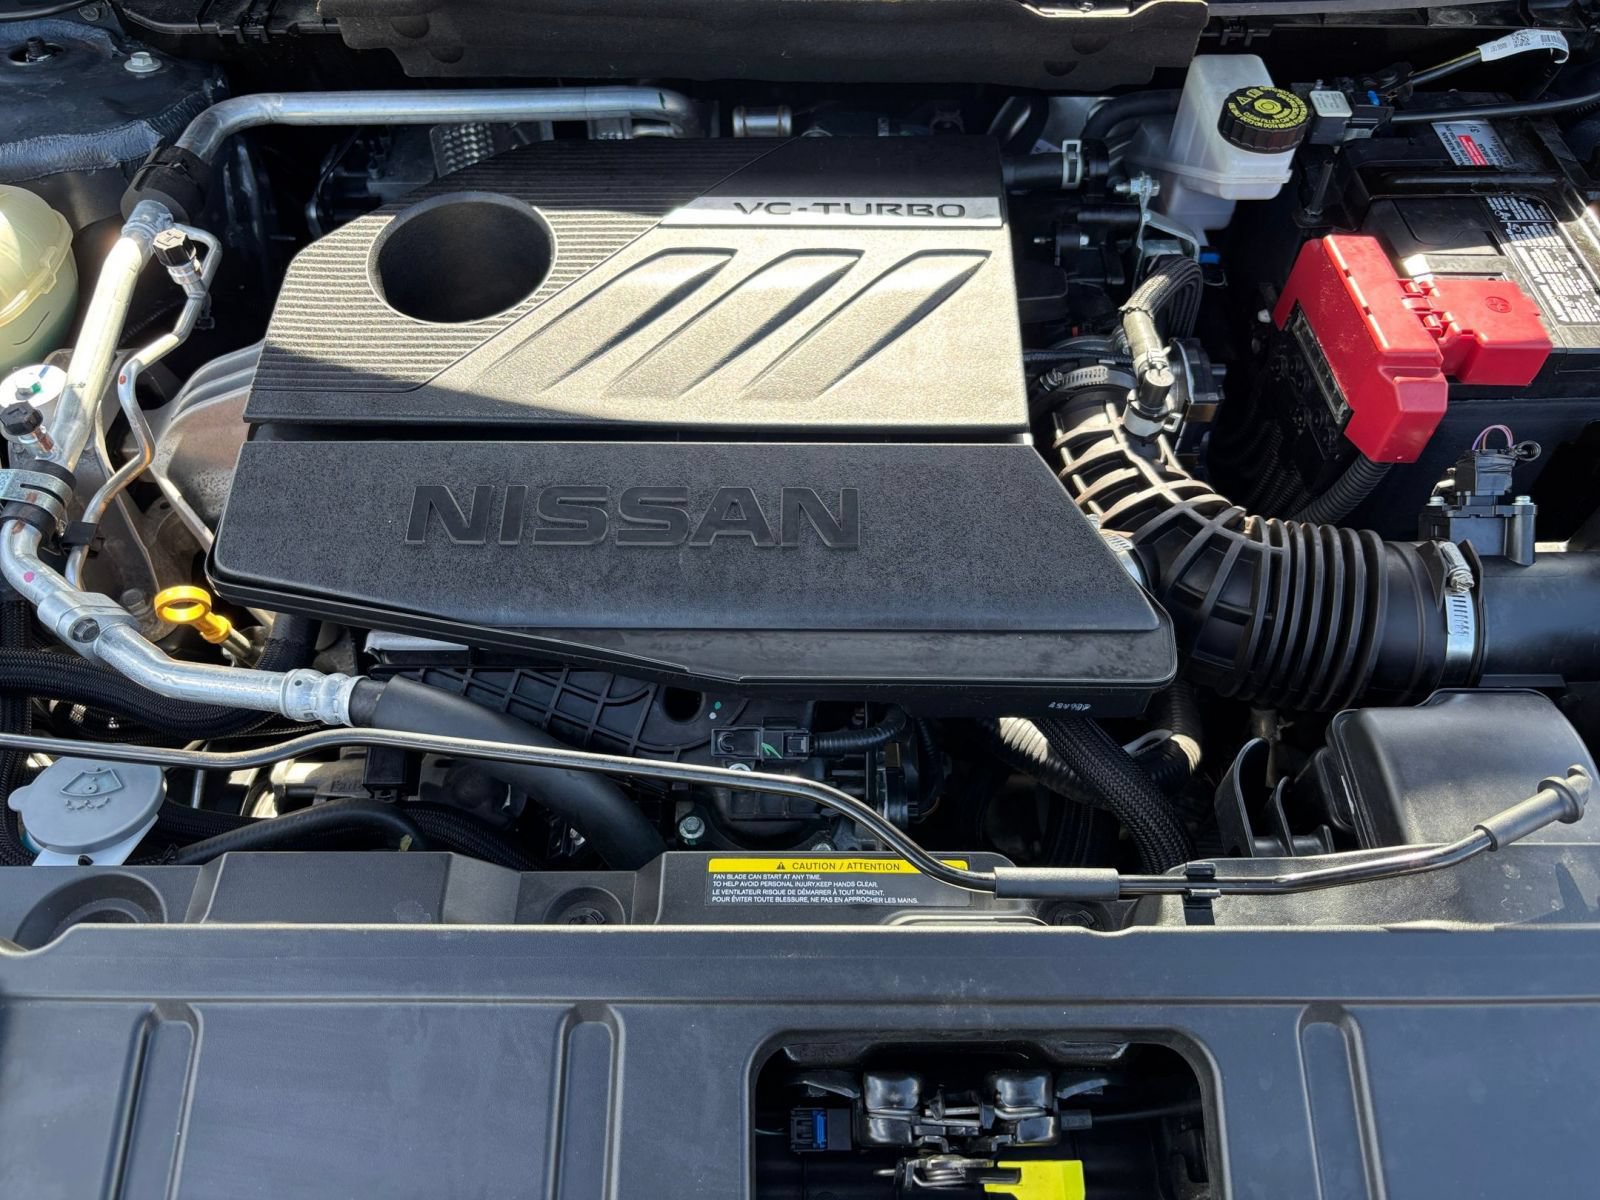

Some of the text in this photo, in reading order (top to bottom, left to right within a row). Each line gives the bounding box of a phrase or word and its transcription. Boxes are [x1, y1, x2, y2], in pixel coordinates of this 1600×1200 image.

[733, 202, 966, 218] VC-TURBO
[404, 484, 860, 549] NISSAN
[792, 862, 900, 871] CAUTION / ATTENTION
